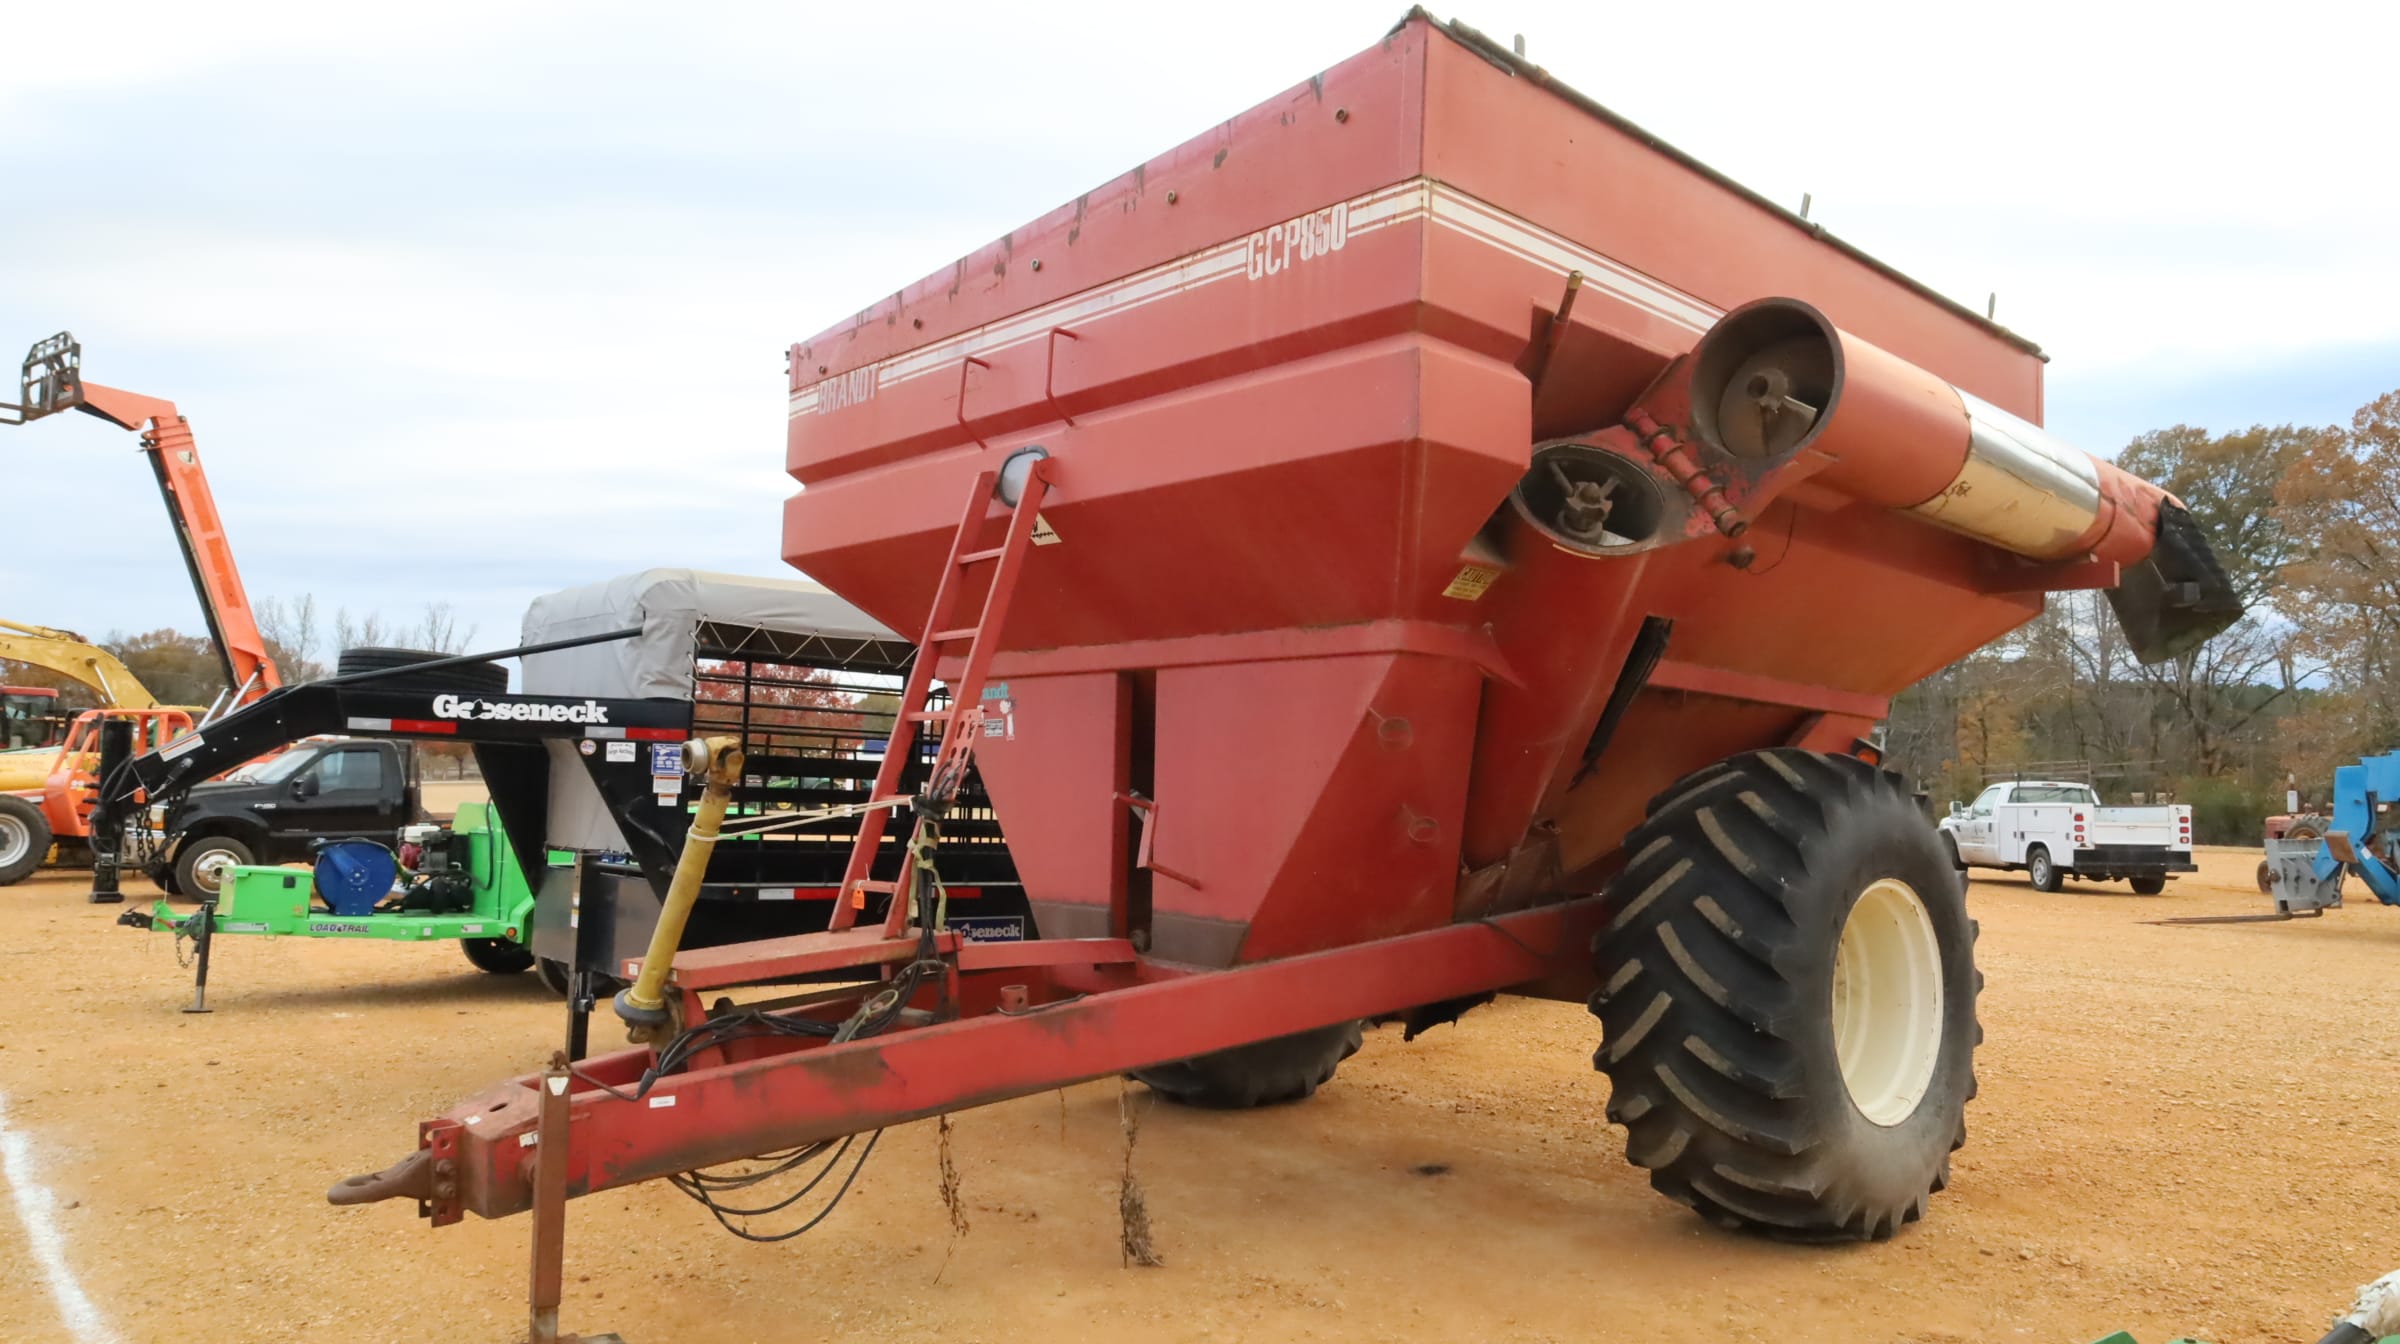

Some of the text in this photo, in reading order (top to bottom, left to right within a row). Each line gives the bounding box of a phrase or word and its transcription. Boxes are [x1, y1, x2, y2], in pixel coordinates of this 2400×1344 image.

[1247, 202, 1348, 281] GCP850
[818, 363, 880, 415] BRANDT
[433, 694, 608, 723] Gooseneck
[309, 923, 369, 933] LOAD TRAIL
